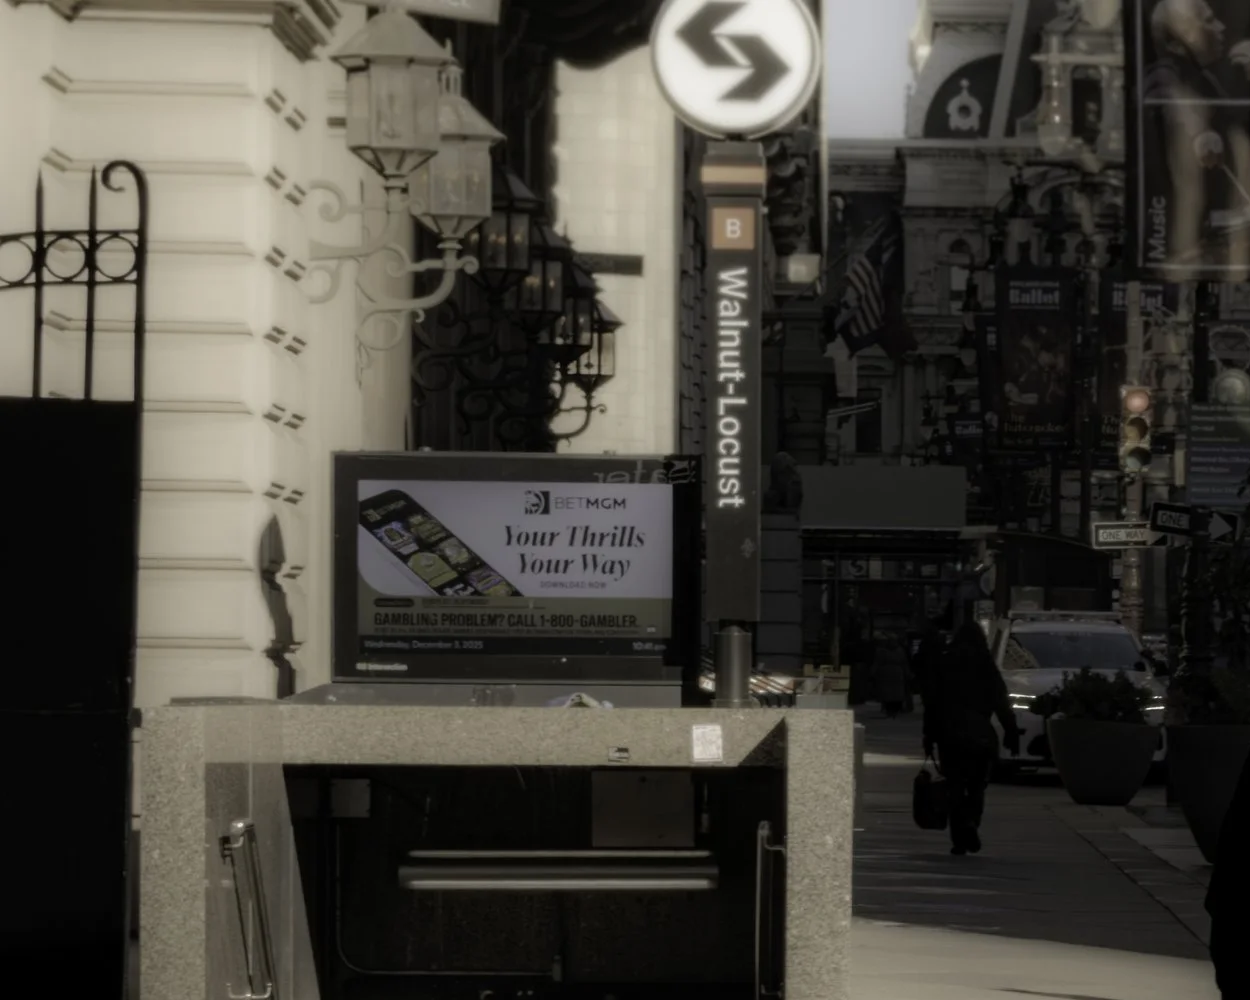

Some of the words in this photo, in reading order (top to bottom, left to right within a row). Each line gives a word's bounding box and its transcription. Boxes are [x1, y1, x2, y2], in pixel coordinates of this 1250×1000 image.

[725, 217, 742, 240] B
[1145, 195, 1167, 261] Music
[1009, 288, 1060, 305] Ballet
[717, 267, 751, 509] Walnut-Locust
[554, 496, 627, 511] BETMGM
[1161, 512, 1187, 527] ONE
[503, 524, 561, 548] Your
[565, 524, 646, 549] Thrills
[1101, 530, 1121, 541] ONE
[1125, 529, 1146, 540] WAY
[518, 552, 575, 575] Your
[579, 552, 631, 582] Way
[374, 611, 438, 627] GAMBLING
[440, 612, 505, 628] PROBLEM?
[507, 613, 536, 628] CALL
